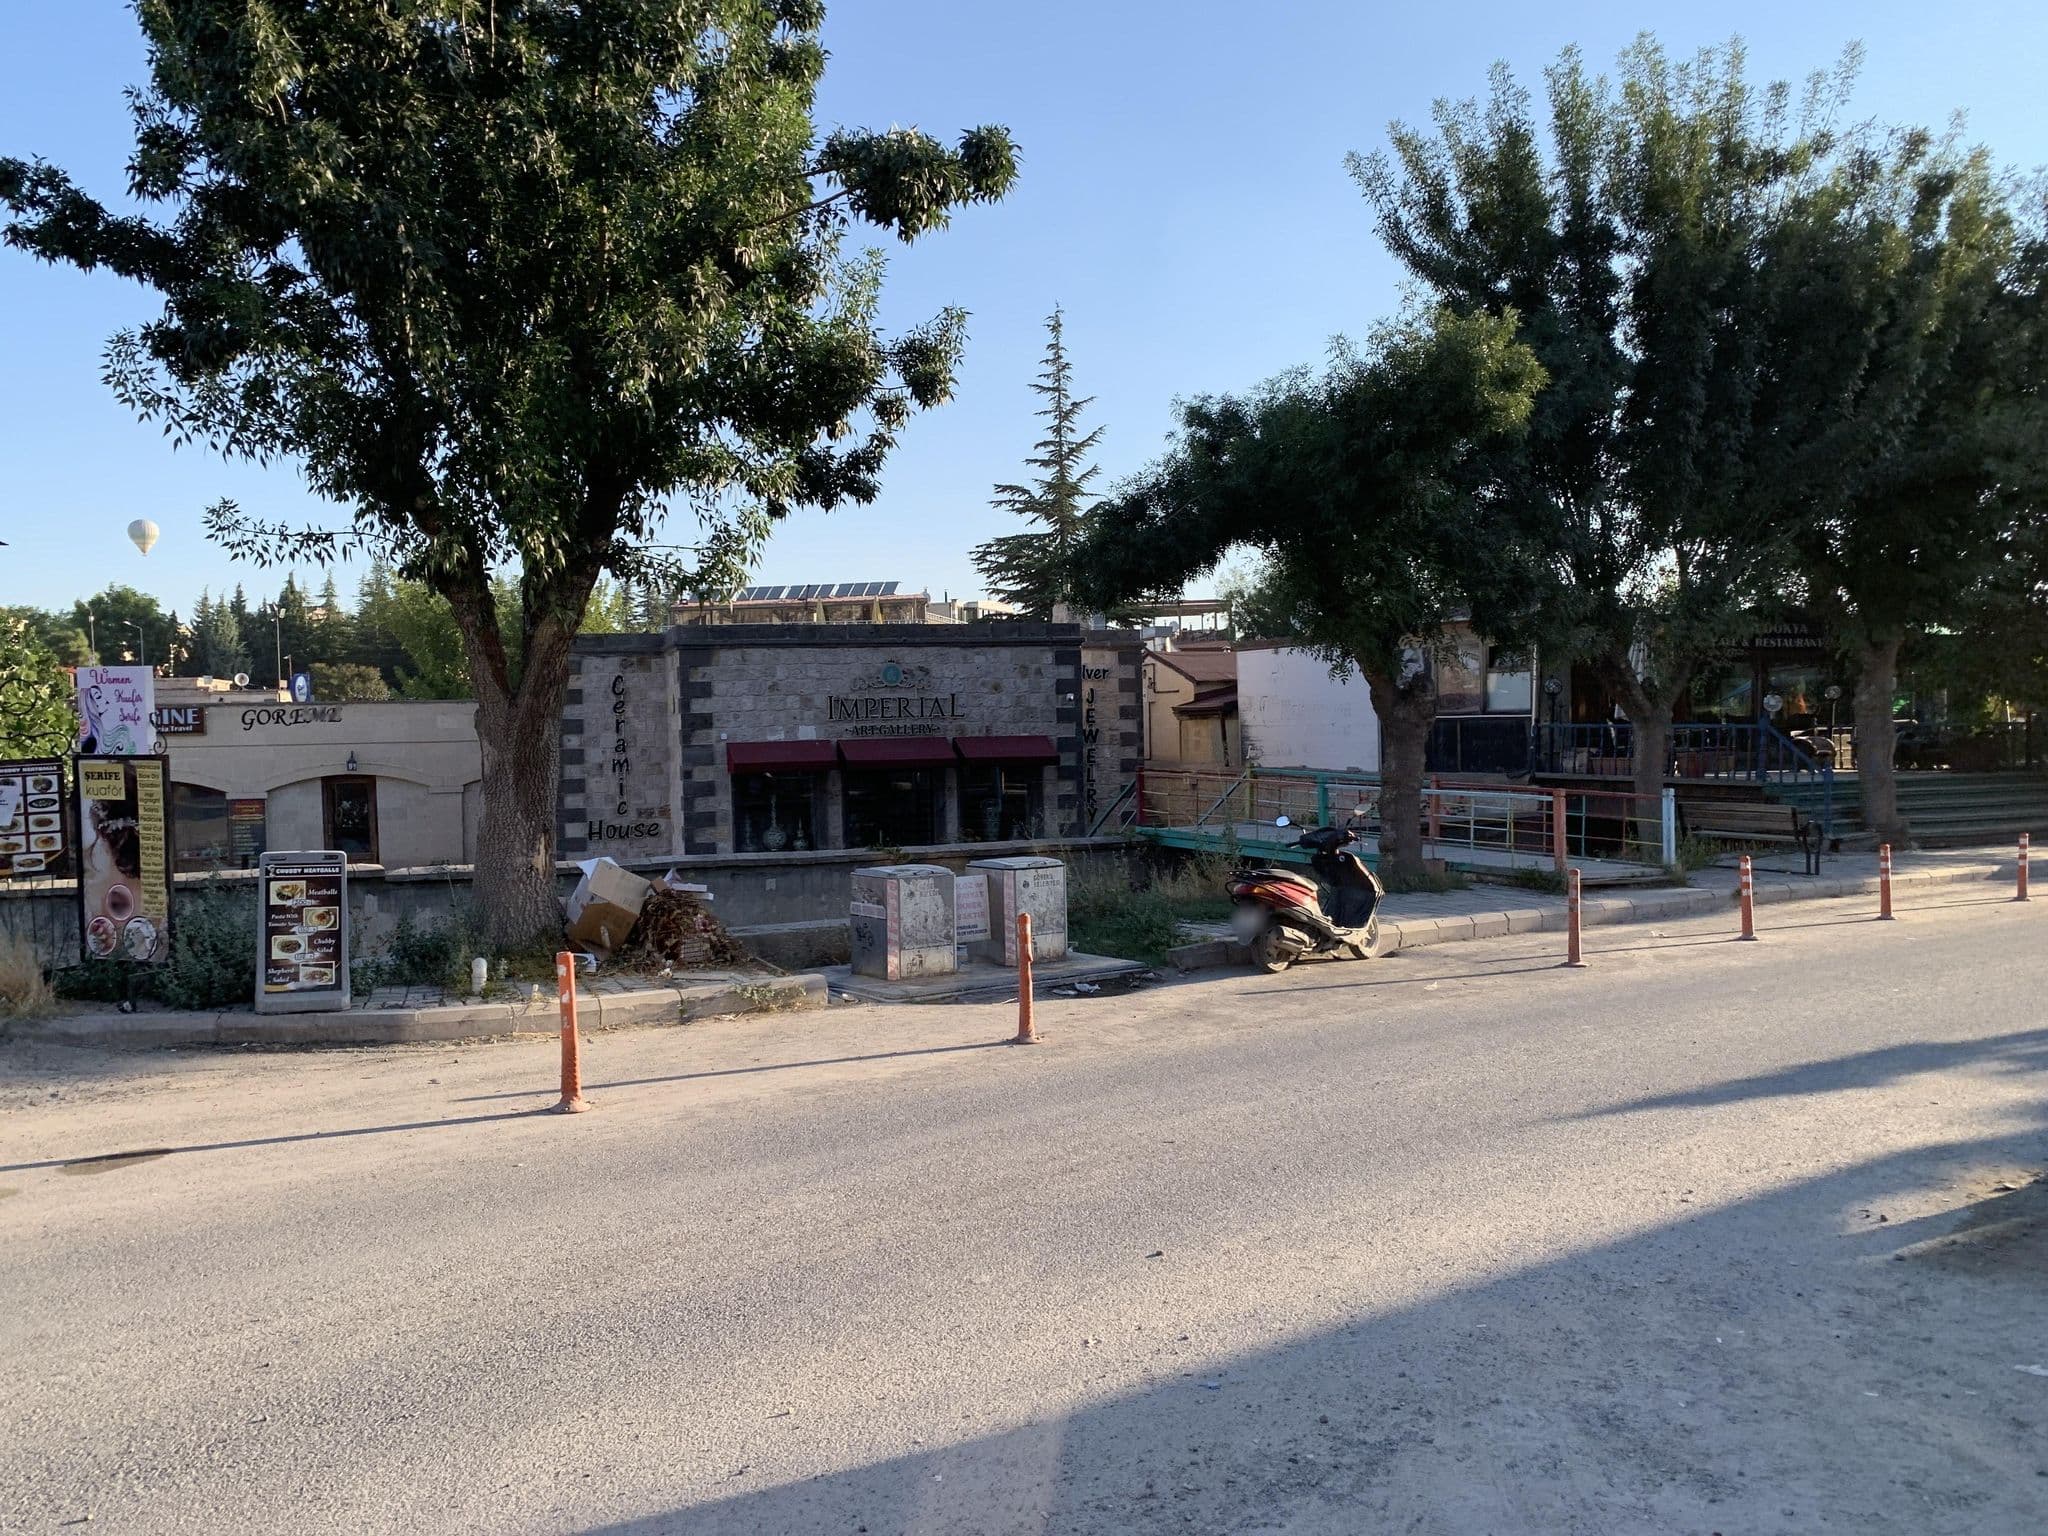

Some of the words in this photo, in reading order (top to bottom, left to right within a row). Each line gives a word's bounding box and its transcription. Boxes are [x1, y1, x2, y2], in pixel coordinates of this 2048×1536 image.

[1755, 638, 1824, 648] RESTAURANT
[89, 668, 132, 685] Women
[1082, 665, 1109, 680] lver
[828, 694, 965, 720] IMPERIAL
[851, 724, 876, 736] ART
[879, 723, 936, 736] GALLERY
[612, 675, 629, 815] Ceramic
[1083, 687, 1099, 824] JEWELRY
[588, 820, 659, 841] House
[308, 888, 338, 897] Meatballs
